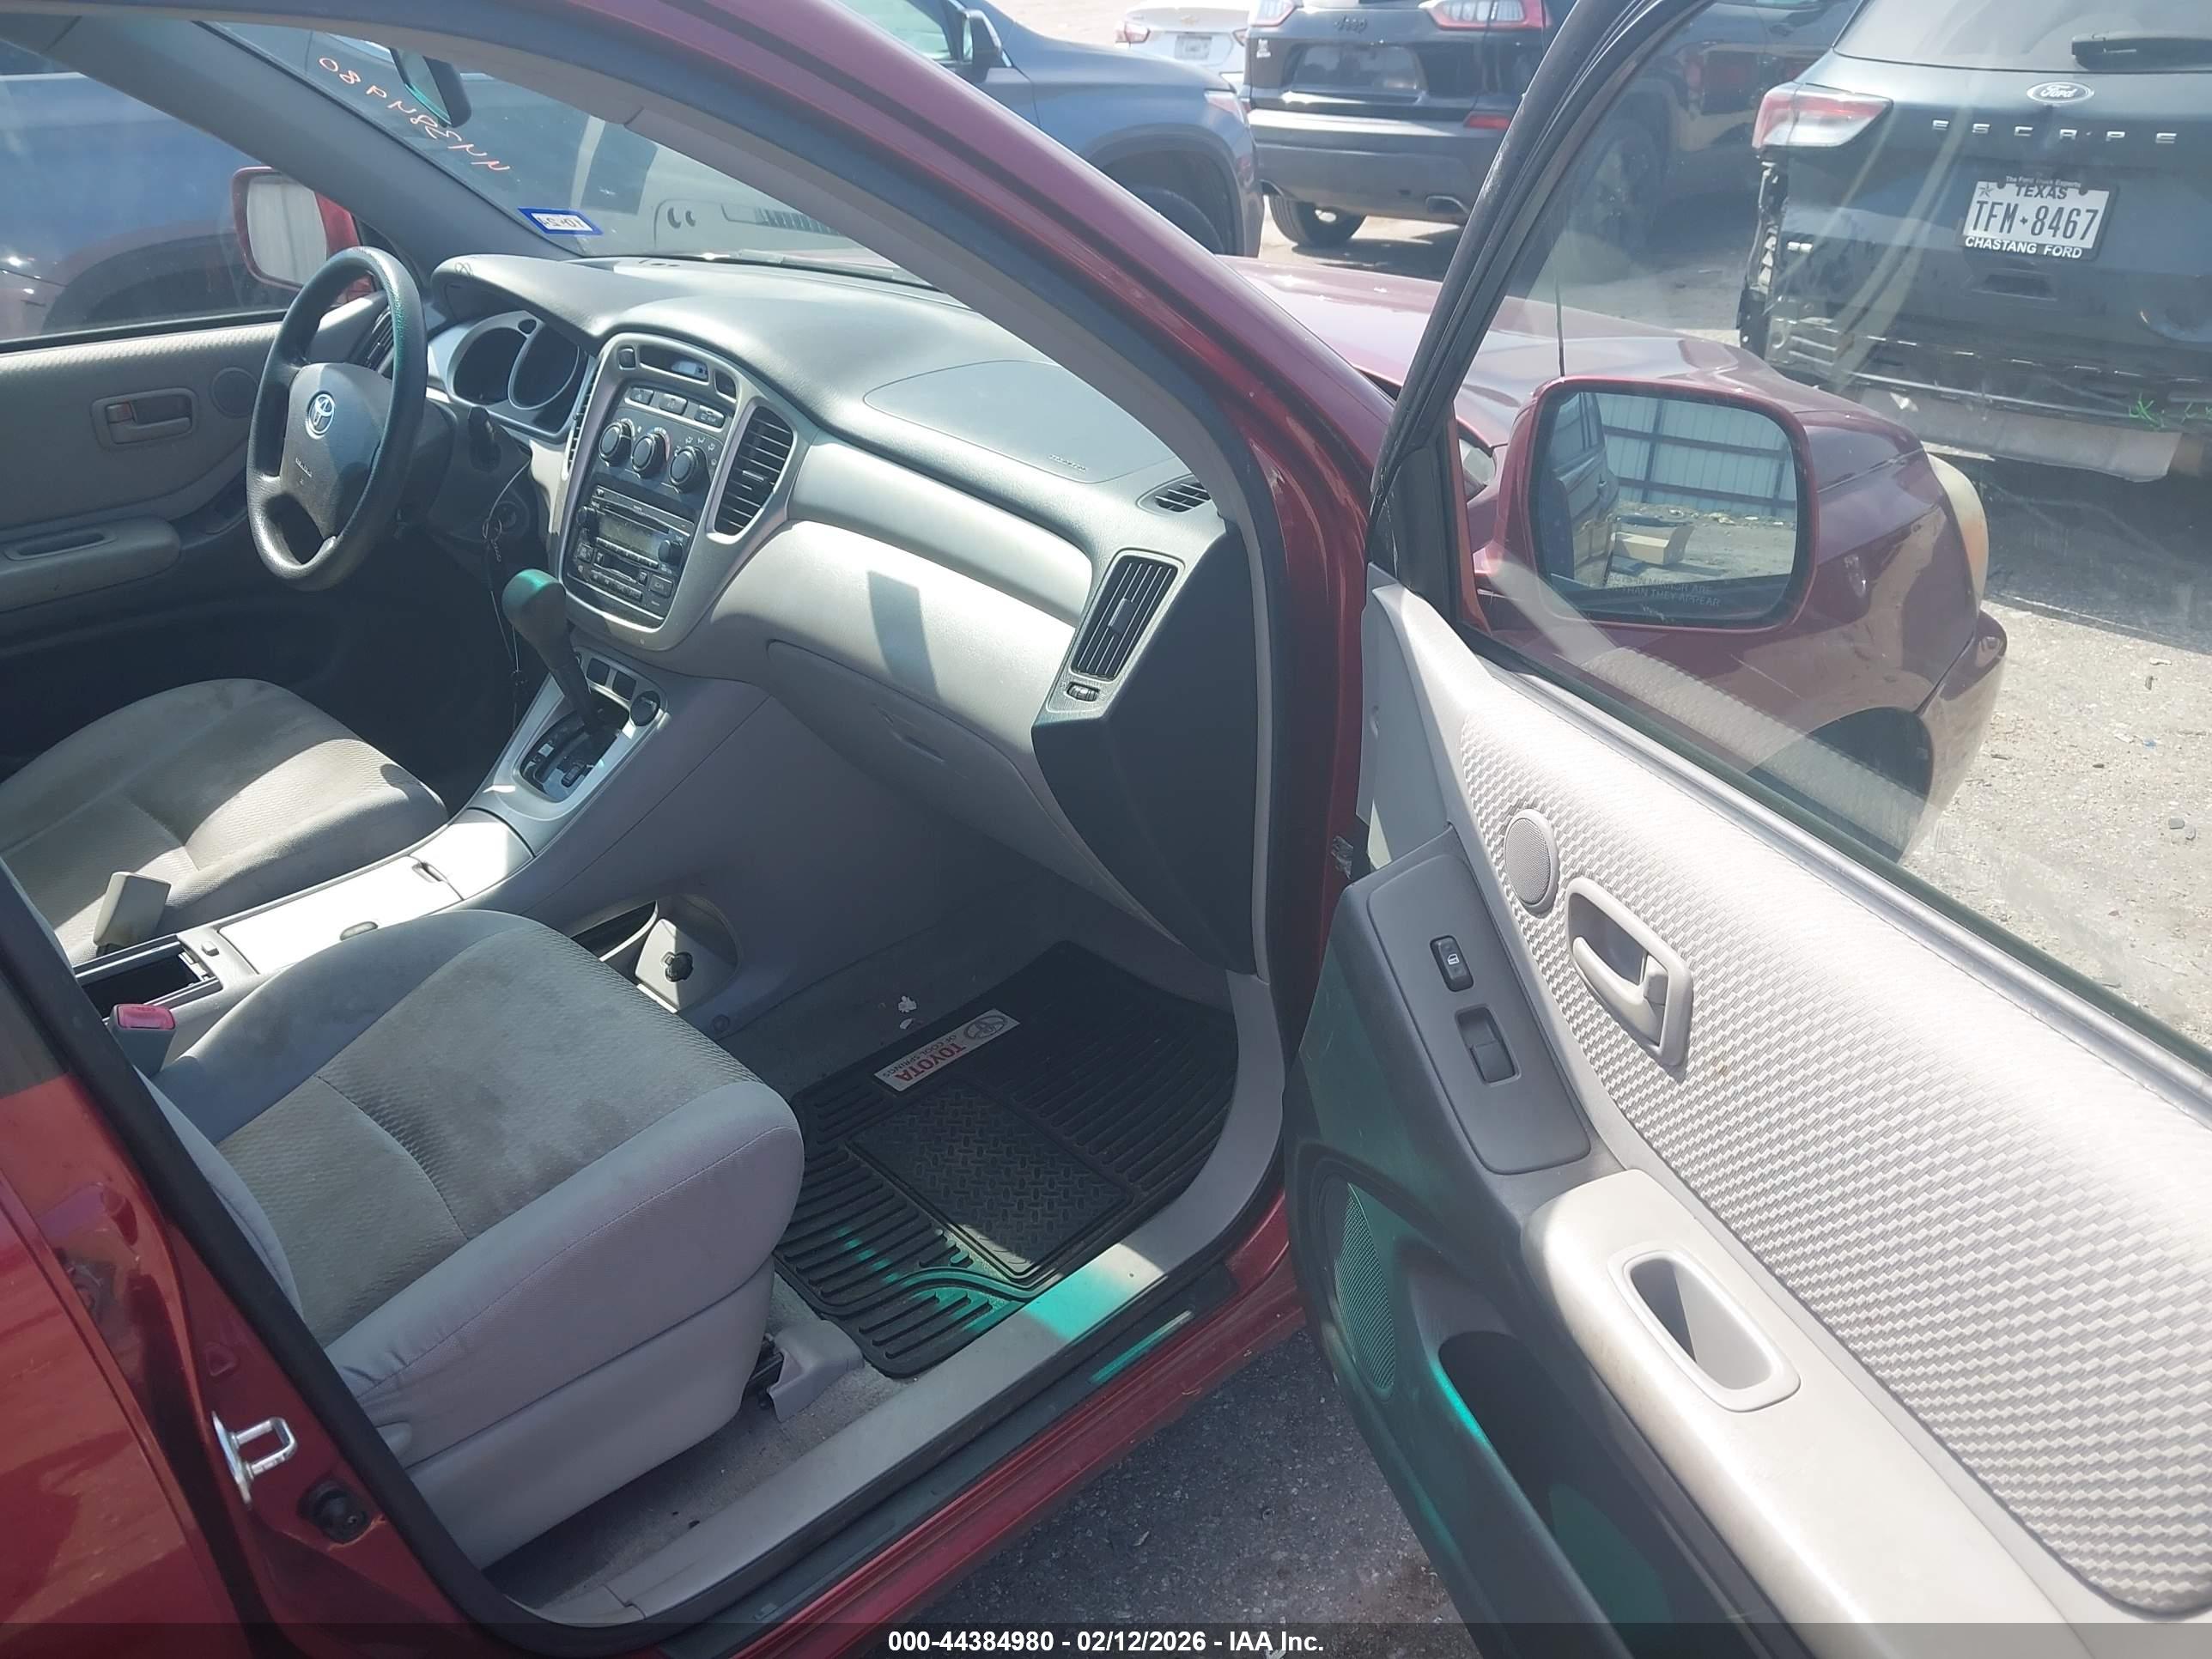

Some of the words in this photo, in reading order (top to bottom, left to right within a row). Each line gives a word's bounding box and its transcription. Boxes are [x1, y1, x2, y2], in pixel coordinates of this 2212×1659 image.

[2039, 84, 2076, 100] Ford
[1932, 119, 2178, 144] ESCAPE
[2015, 185, 2069, 200] TEXAS
[1965, 236, 2037, 254] CHASTANG
[2044, 245, 2082, 258] FORD
[895, 1042, 967, 1082] TOYOTA
